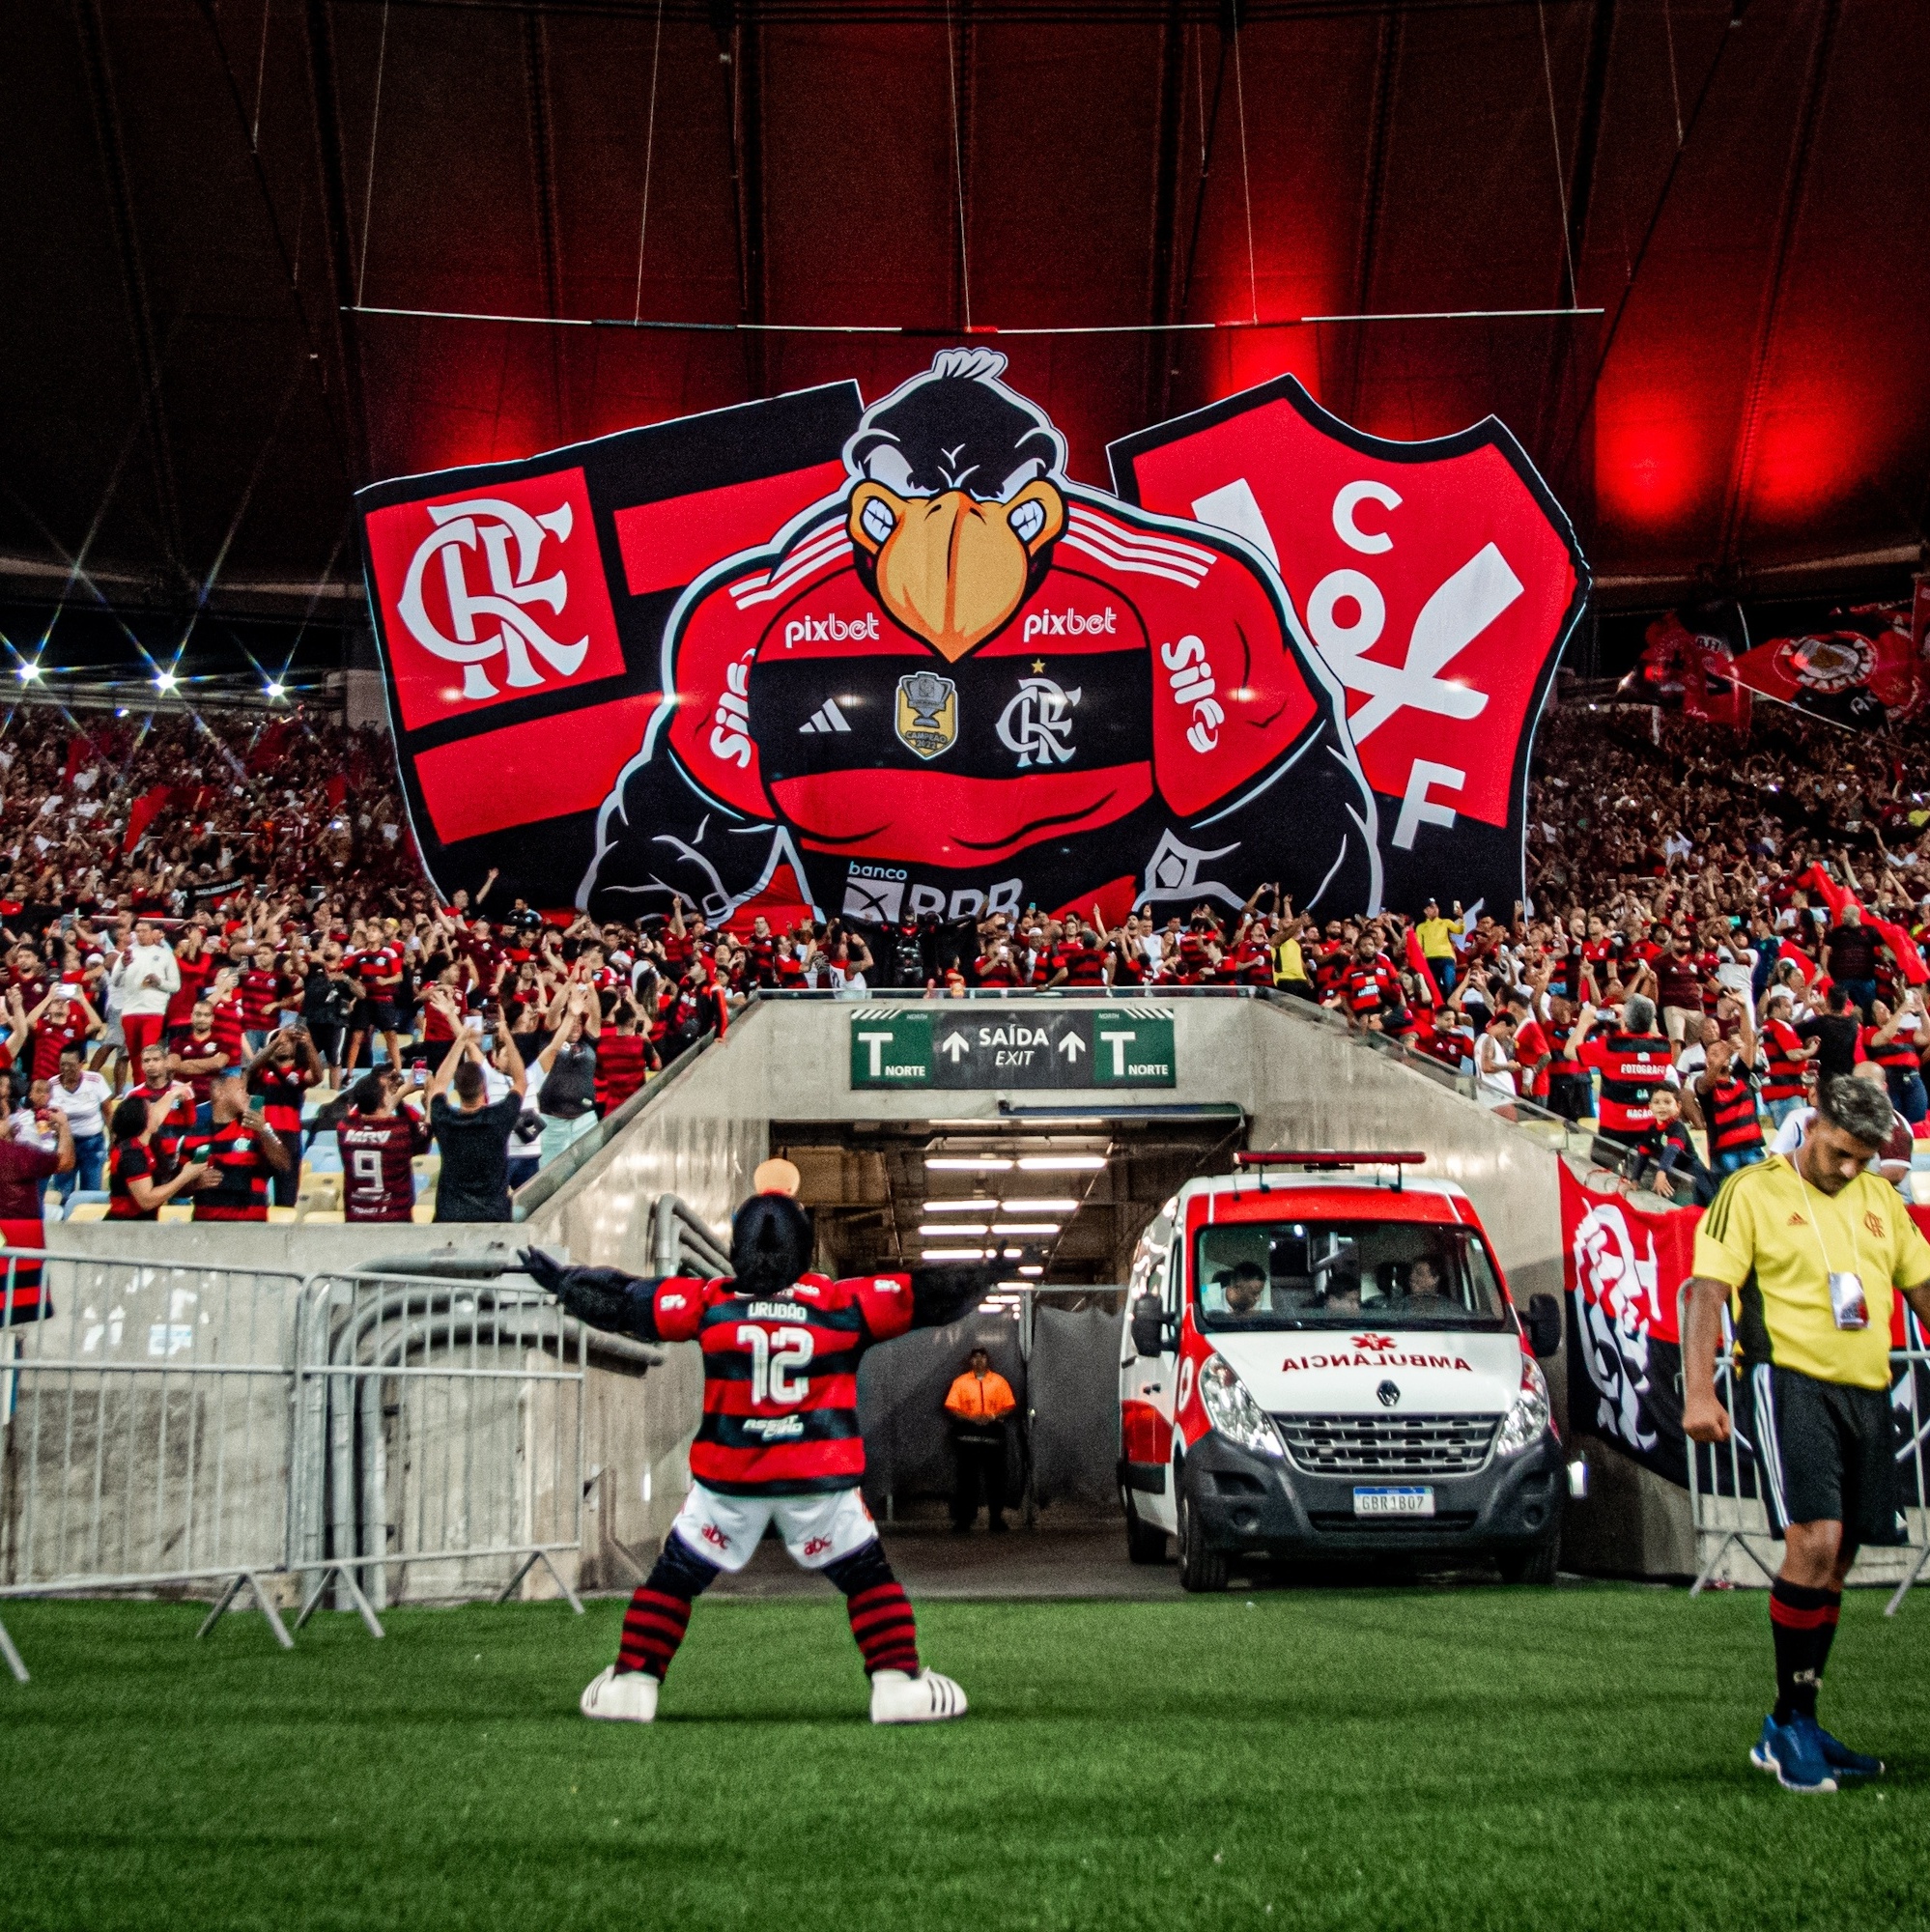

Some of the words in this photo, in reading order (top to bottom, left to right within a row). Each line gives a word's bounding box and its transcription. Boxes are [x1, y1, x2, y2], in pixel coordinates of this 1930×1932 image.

[785, 611, 880, 649] pixbet
[1023, 606, 1117, 643] pixbet
[1392, 757, 1466, 851] F
[848, 861, 908, 881] banco
[979, 1024, 1050, 1046] SAÍDA
[1100, 1031, 1136, 1075] T
[858, 1032, 894, 1076] T
[885, 1065, 925, 1077] NORTE
[995, 1050, 1036, 1066] EXIT
[1128, 1064, 1169, 1075] NORTE
[353, 1149, 384, 1193] 9
[737, 1324, 815, 1405] 12
[1362, 1495, 1425, 1511] GBR1B07
